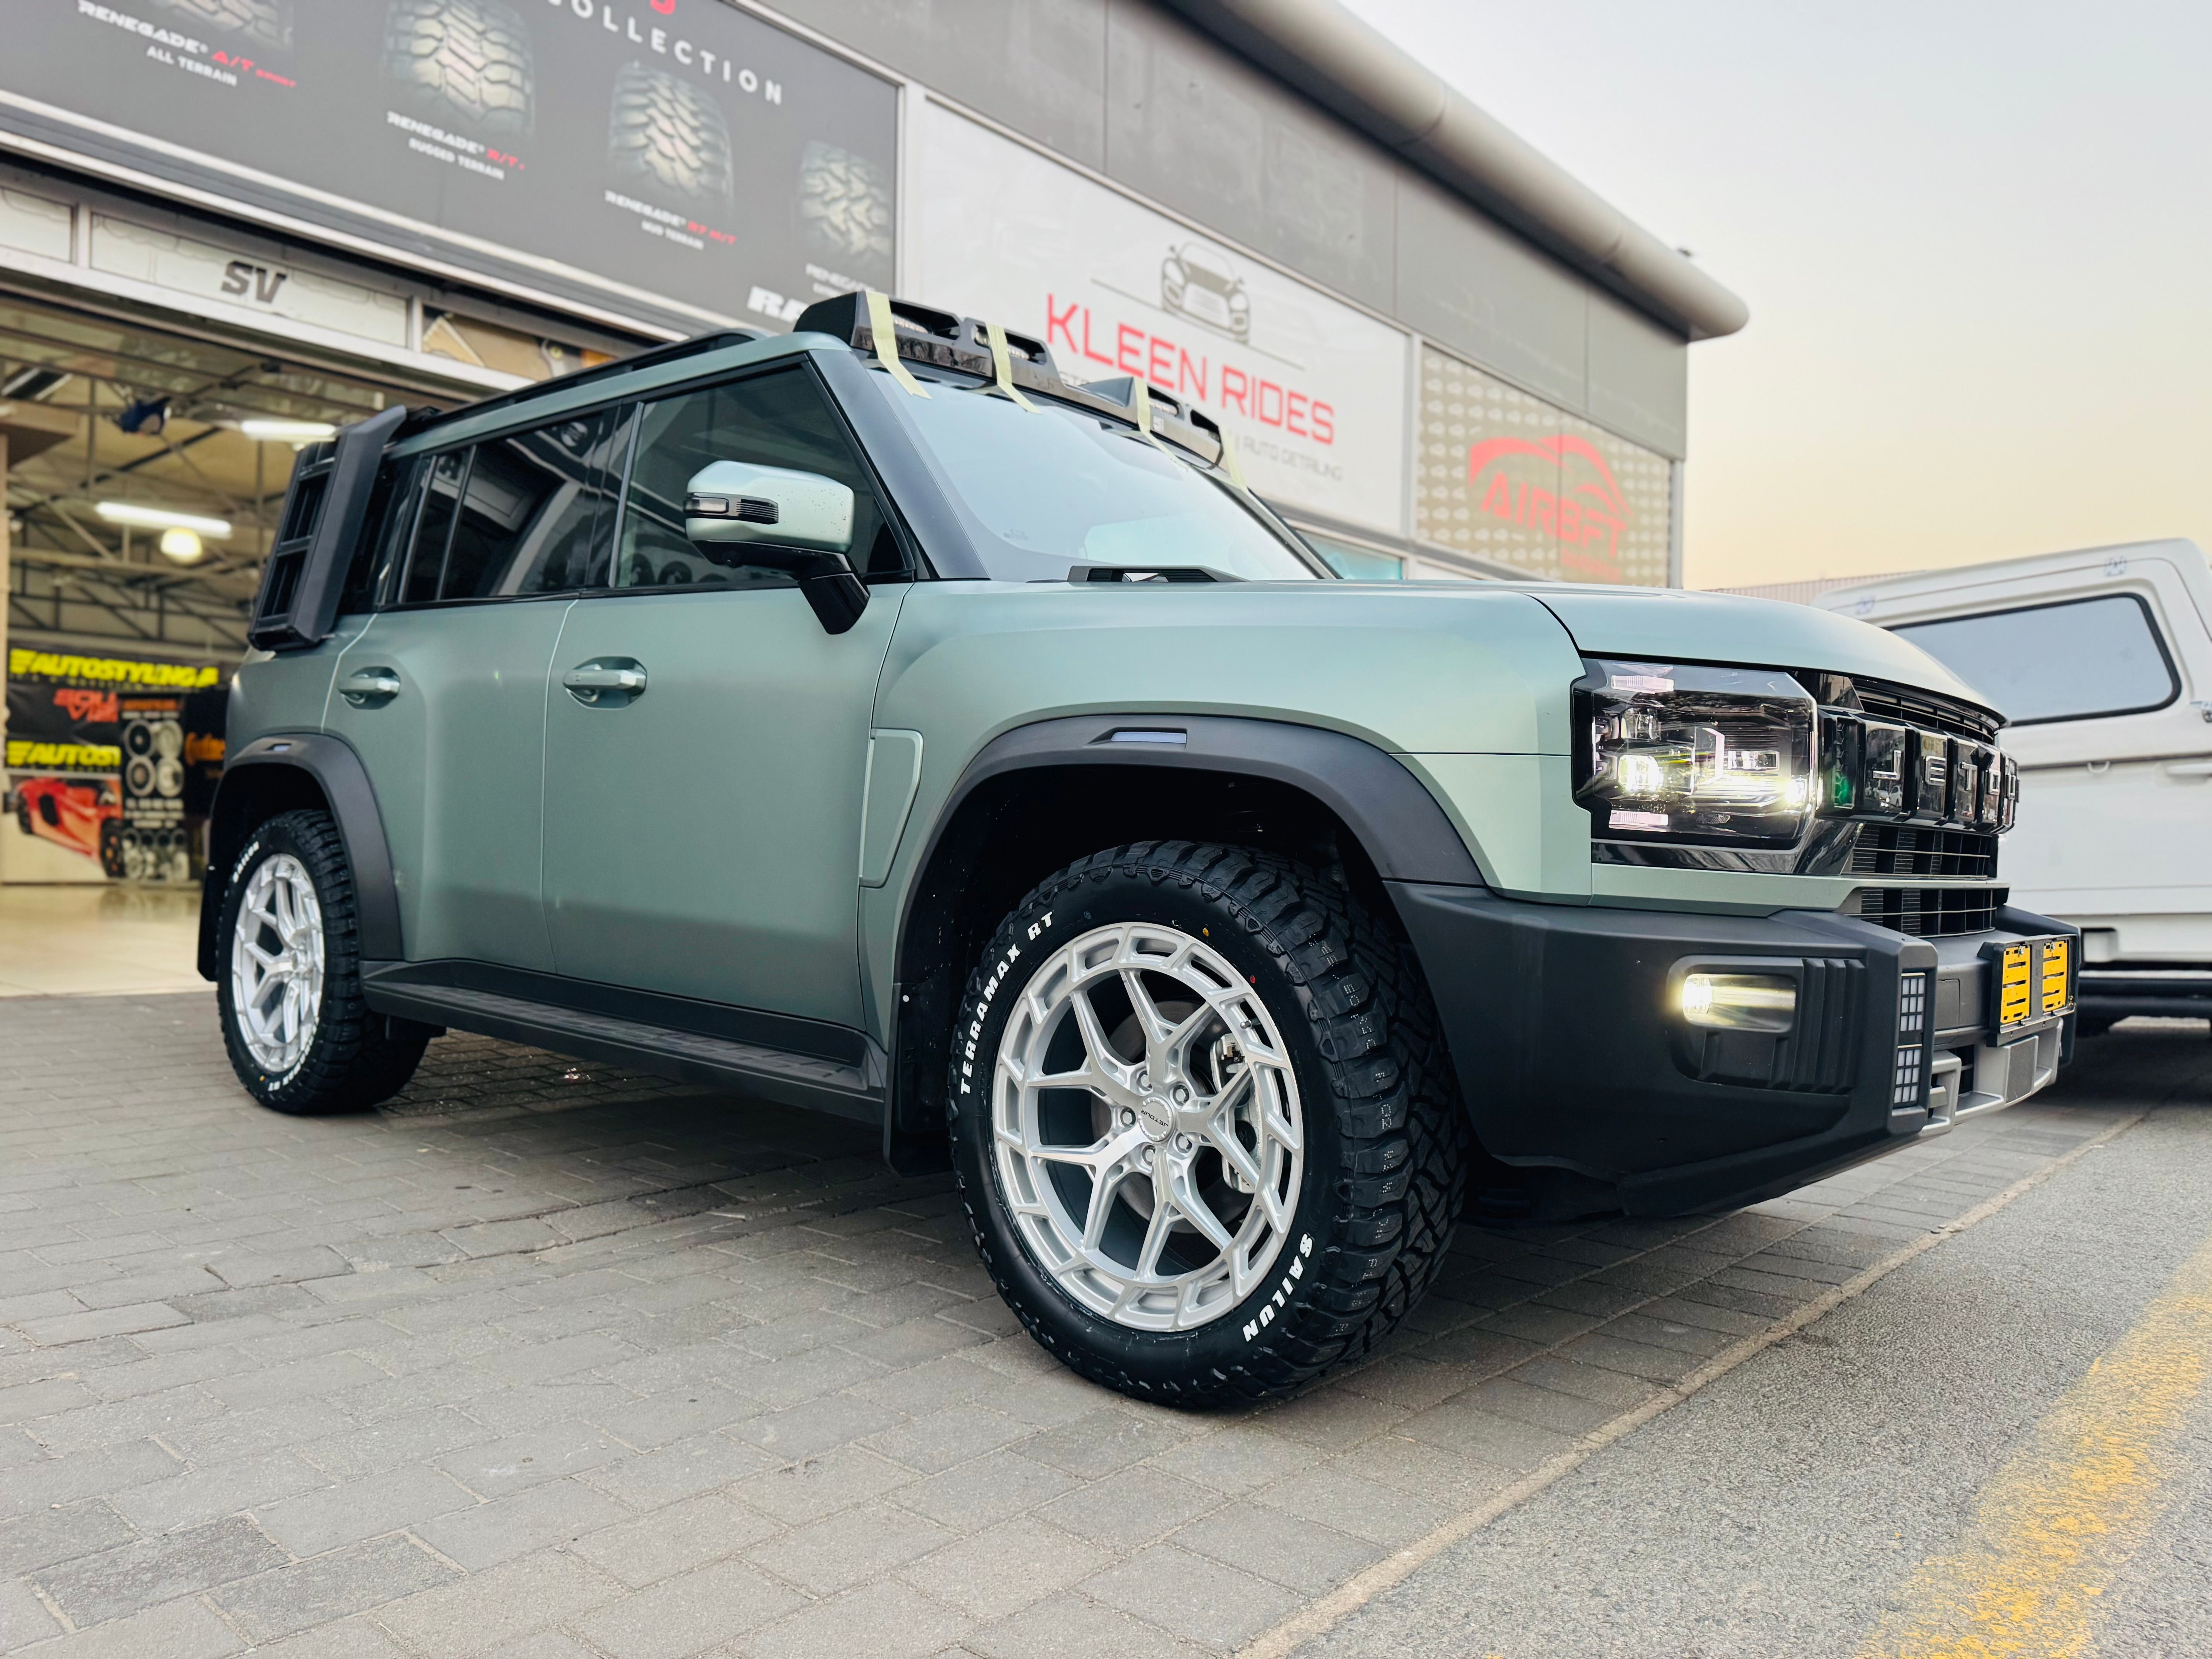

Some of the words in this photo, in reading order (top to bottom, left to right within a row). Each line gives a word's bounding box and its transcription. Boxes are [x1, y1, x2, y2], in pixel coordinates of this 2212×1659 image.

[146, 46, 175, 65] ALL
[178, 56, 237, 86] TERRAIN
[212, 51, 254, 71] A/T
[548, 0, 782, 105] OLLECTION
[457, 155, 504, 180] TERRAIN
[221, 261, 287, 303] SV
[1048, 293, 1207, 402] KLEEN
[1221, 364, 1334, 445] RIDES
[1873, 750, 2020, 803] JETOU
[961, 943, 1021, 1094] TERRAMAX
[1027, 911, 1053, 941] RT
[1141, 1109, 1169, 1127] JETOUR
[1242, 1233, 1313, 1342] SAILUN
